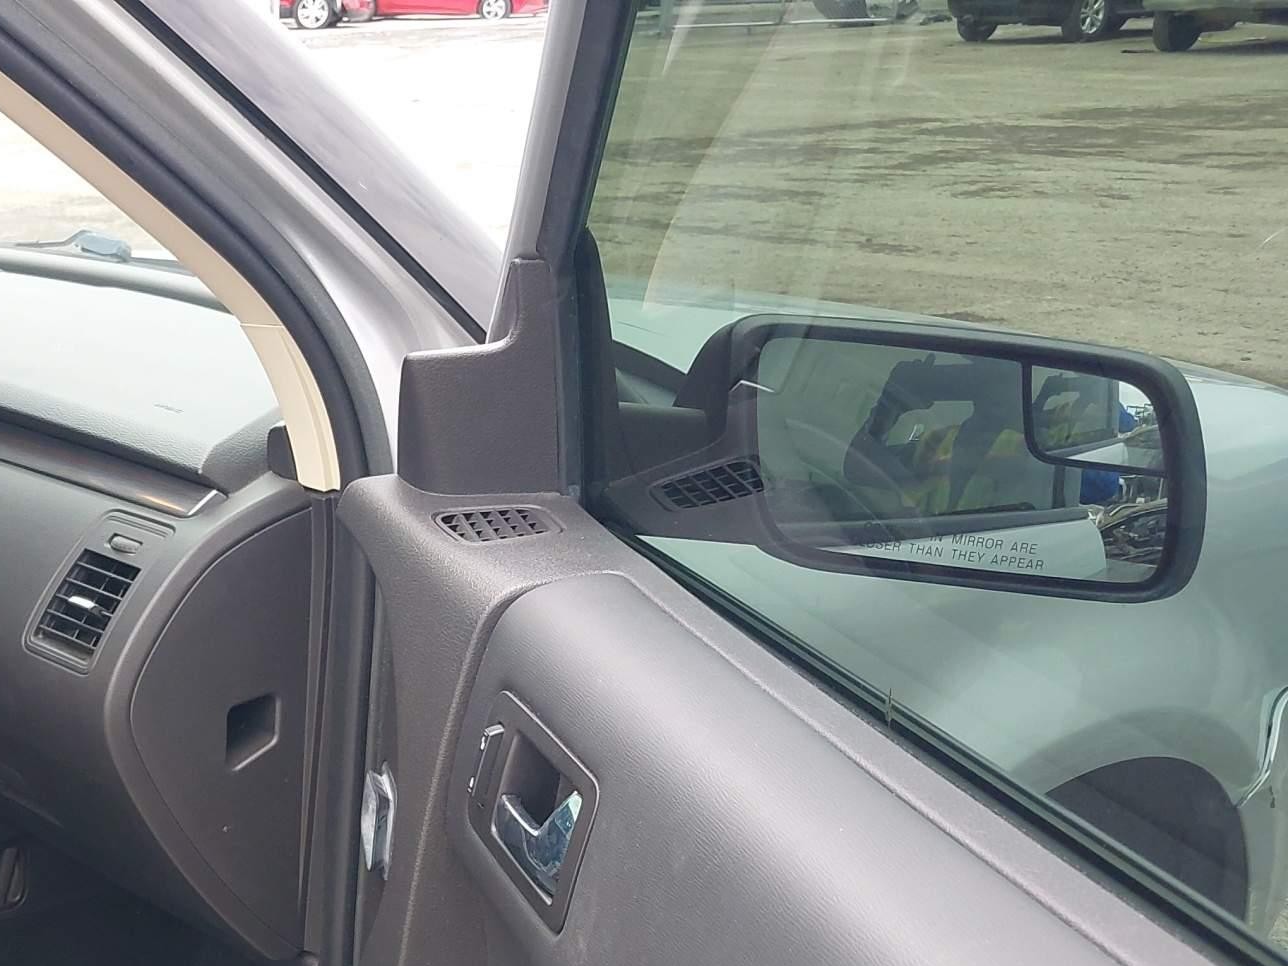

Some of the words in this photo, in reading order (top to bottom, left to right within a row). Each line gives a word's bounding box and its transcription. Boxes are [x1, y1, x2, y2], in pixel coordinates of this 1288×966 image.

[909, 542, 944, 558] THAN
[951, 549, 986, 563] THEY
[990, 554, 1044, 570] APPEAR
[951, 533, 1004, 550] MIRROR
[1010, 542, 1039, 555] ARE
